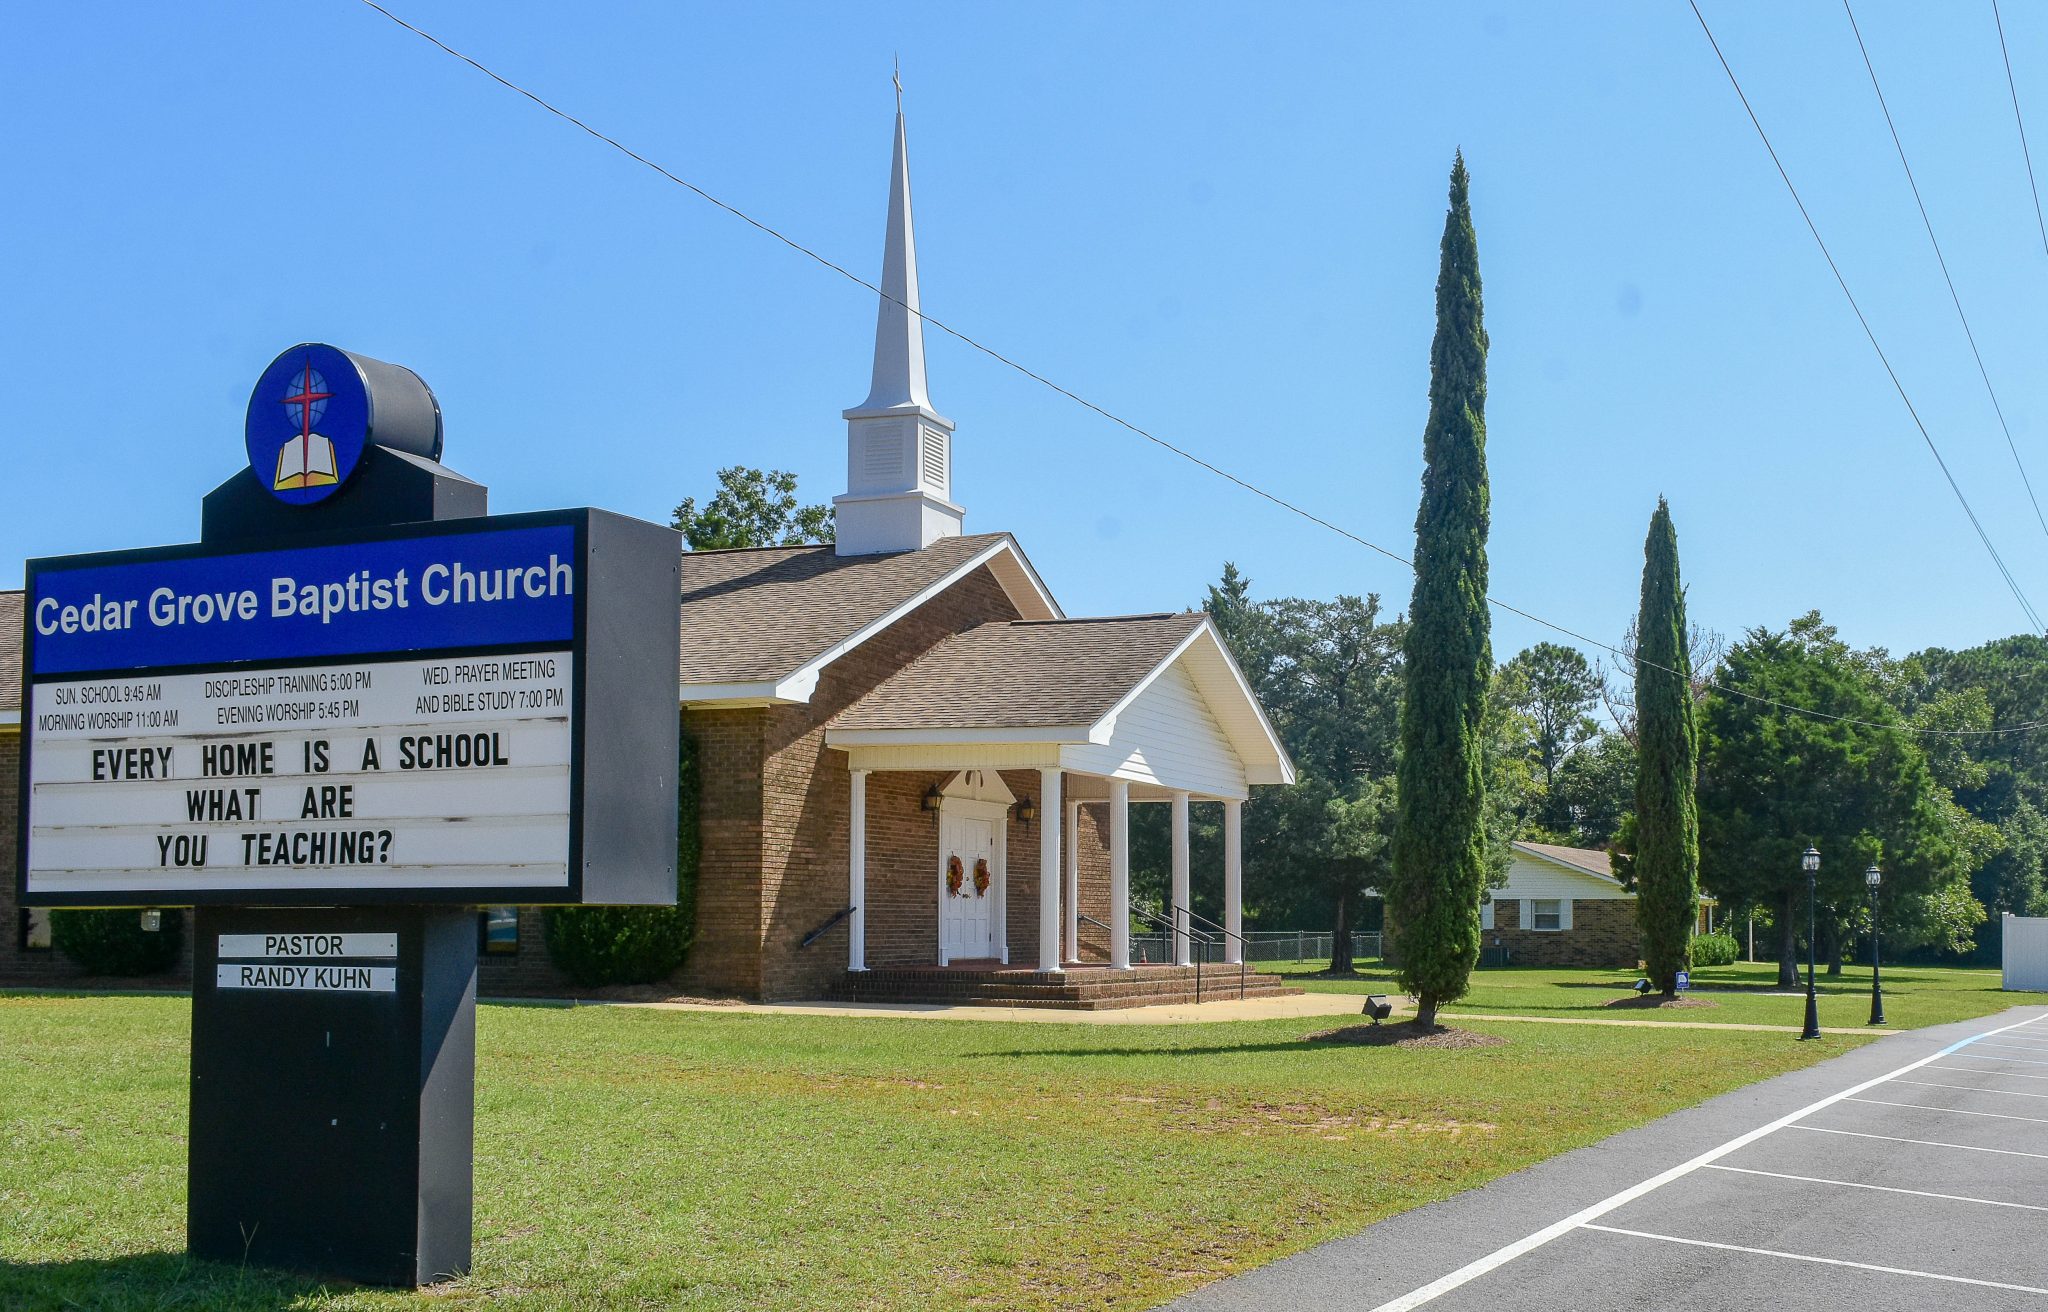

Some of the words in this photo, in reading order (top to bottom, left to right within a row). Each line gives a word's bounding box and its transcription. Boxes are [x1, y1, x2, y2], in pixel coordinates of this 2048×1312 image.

[35, 593, 138, 635] Cedar
[149, 587, 258, 627] Grove
[271, 568, 409, 624] Baptist
[421, 554, 573, 606] Church
[205, 677, 275, 698] DISCIPLESHIP
[278, 673, 328, 694] TRAINING
[330, 673, 351, 691] 5:00
[355, 671, 371, 689] PM
[422, 666, 451, 685] WED.
[455, 663, 499, 683] PRAYER
[502, 659, 555, 681] MEETING
[55, 688, 78, 705] SUN.
[81, 686, 122, 704] SCHOOL
[124, 685, 144, 702] 9:45
[146, 683, 162, 701] AM
[415, 695, 440, 714] AND
[443, 693, 475, 713] BIBLE
[477, 691, 516, 711] STUDY
[519, 689, 543, 708] 7:00
[546, 688, 563, 707] PM
[39, 713, 85, 731] MORNING
[87, 711, 133, 730] WORSHIP
[136, 710, 160, 727] 11:00
[163, 709, 179, 727] AM
[217, 704, 263, 724] EVENING
[265, 702, 316, 721] WORSHIP
[318, 701, 340, 719] 5:45
[343, 699, 359, 718] PM
[93, 746, 173, 780] EVERY
[202, 742, 274, 777] HOME
[304, 740, 329, 773] IS
[361, 737, 380, 771] A
[399, 732, 508, 770] SCHOOL
[186, 788, 260, 821] WHAT
[300, 785, 353, 819] ARE
[157, 834, 207, 867] YOU
[241, 829, 393, 866] TEACHING?
[265, 935, 344, 955] PASTOR
[241, 967, 309, 987] RANDY
[315, 968, 372, 989] KUHN
